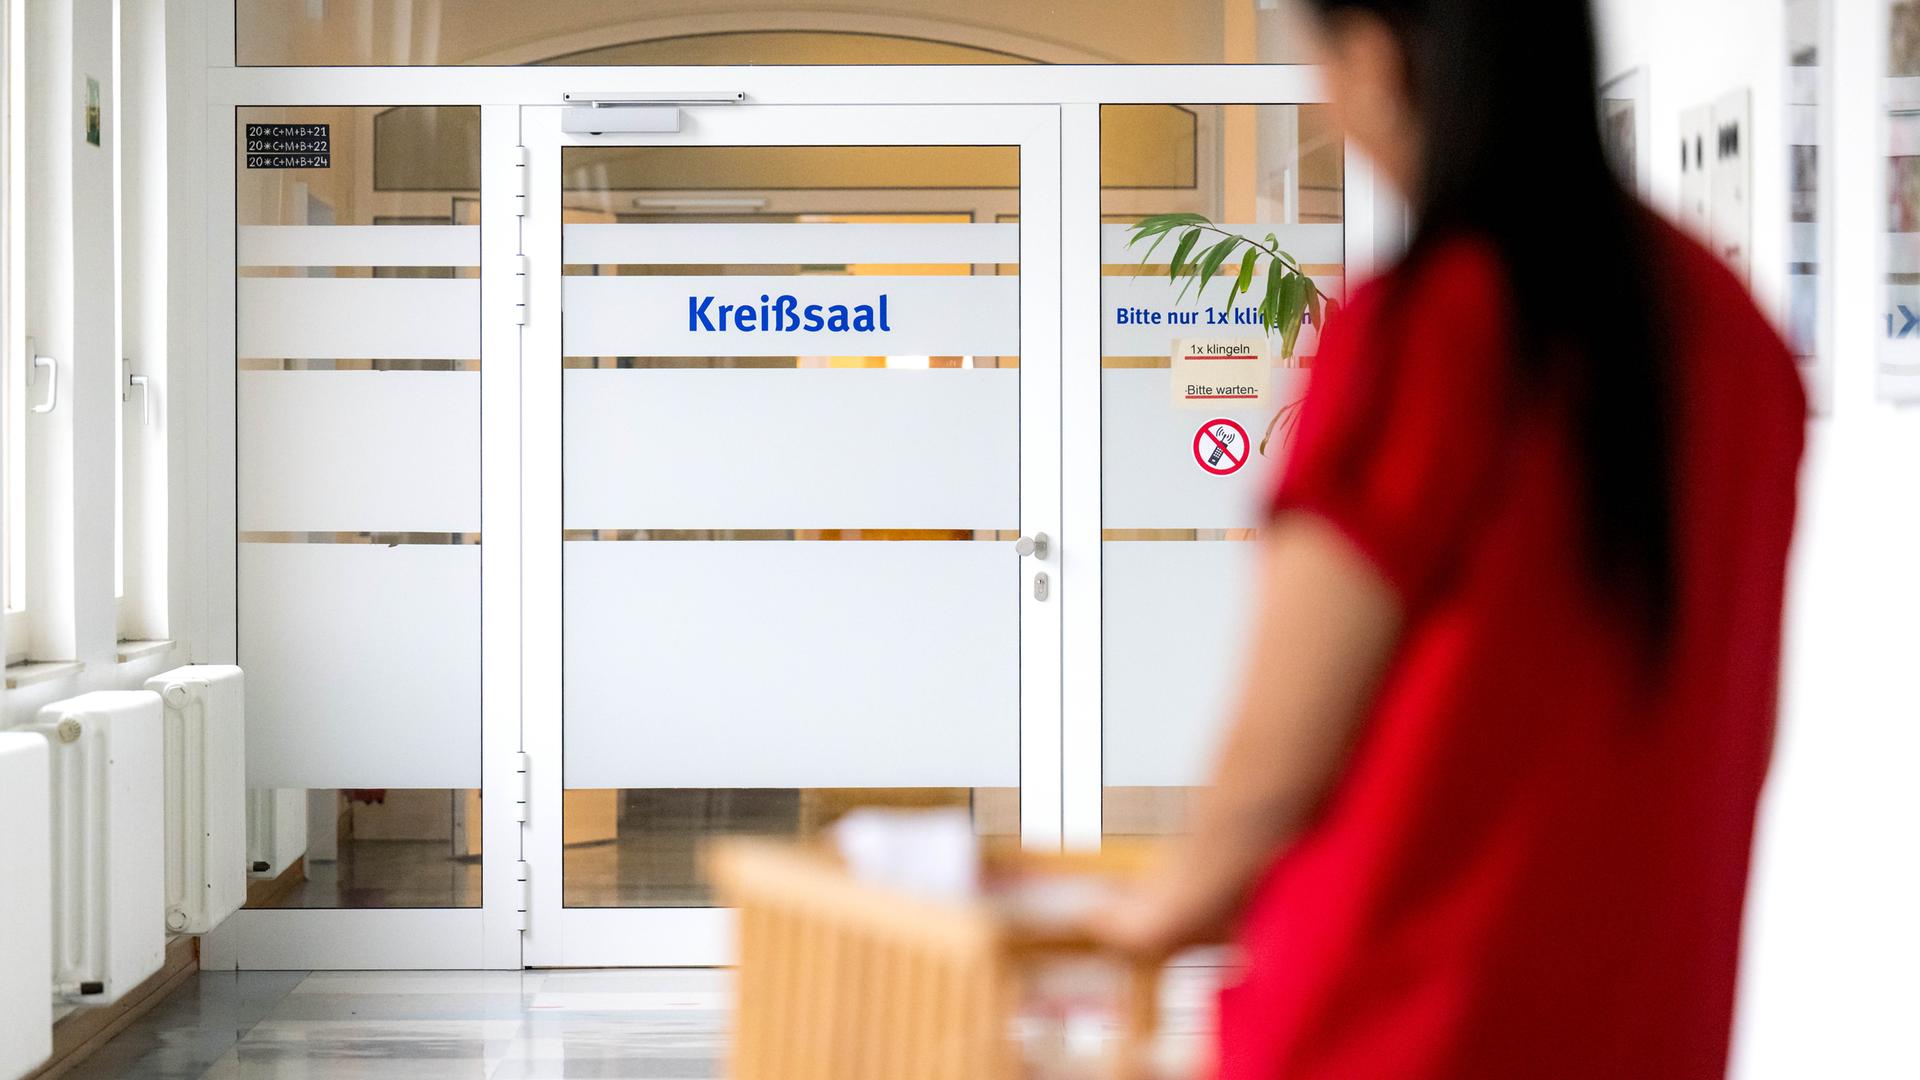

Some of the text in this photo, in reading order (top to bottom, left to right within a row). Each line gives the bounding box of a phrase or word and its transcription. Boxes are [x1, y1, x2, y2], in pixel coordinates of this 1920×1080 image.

[689, 294, 890, 332] Kreißsaal
[1116, 307, 1161, 325] Bitte
[1168, 311, 1198, 325] nur
[1206, 307, 1228, 325] 1x
[1190, 344, 1250, 356] 1x klingeln
[1216, 385, 1258, 395] warten-
